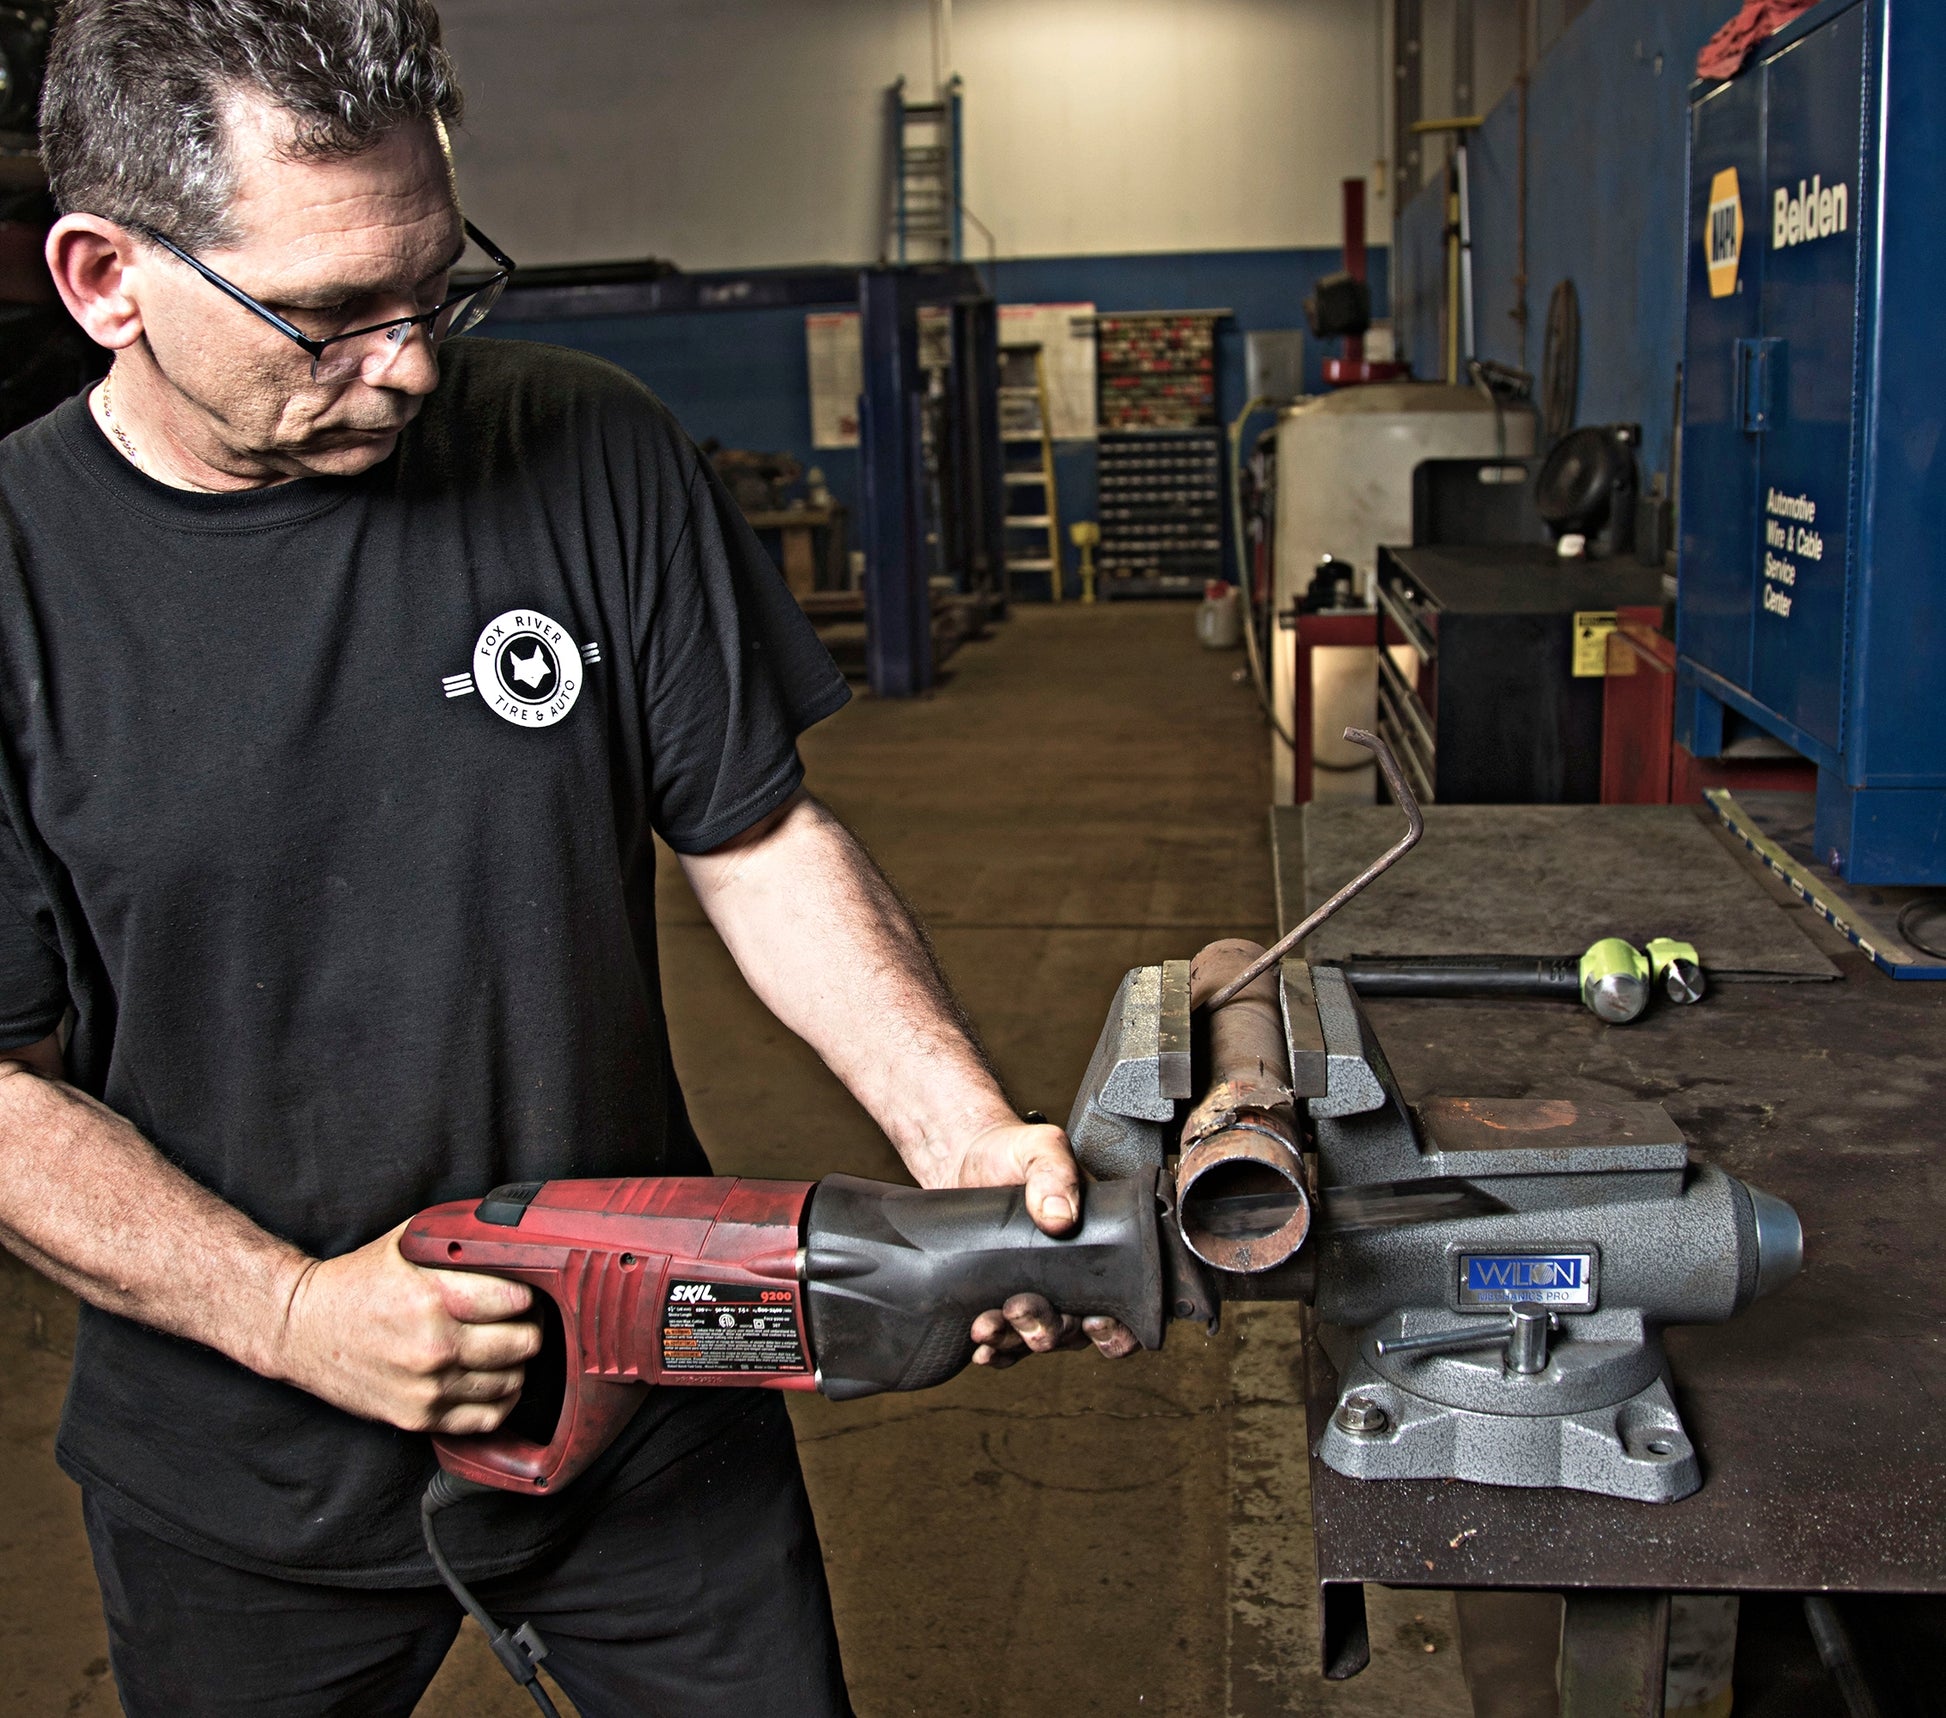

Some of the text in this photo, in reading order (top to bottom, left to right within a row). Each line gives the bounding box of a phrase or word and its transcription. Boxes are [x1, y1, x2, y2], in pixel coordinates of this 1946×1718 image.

[1773, 174, 1848, 249] Belden
[1767, 487, 1816, 523] Automotive
[1766, 519, 1823, 560] Wire & Cable
[1765, 551, 1796, 586] Service
[1763, 583, 1792, 617] Center
[481, 616, 562, 656] FOX RIVER
[495, 695, 528, 720] TIRE
[550, 680, 575, 717] AUTO
[1476, 1261, 1574, 1286] WILTON
[761, 1291, 792, 1303] 9200
[1546, 1291, 1570, 1300] PRO
